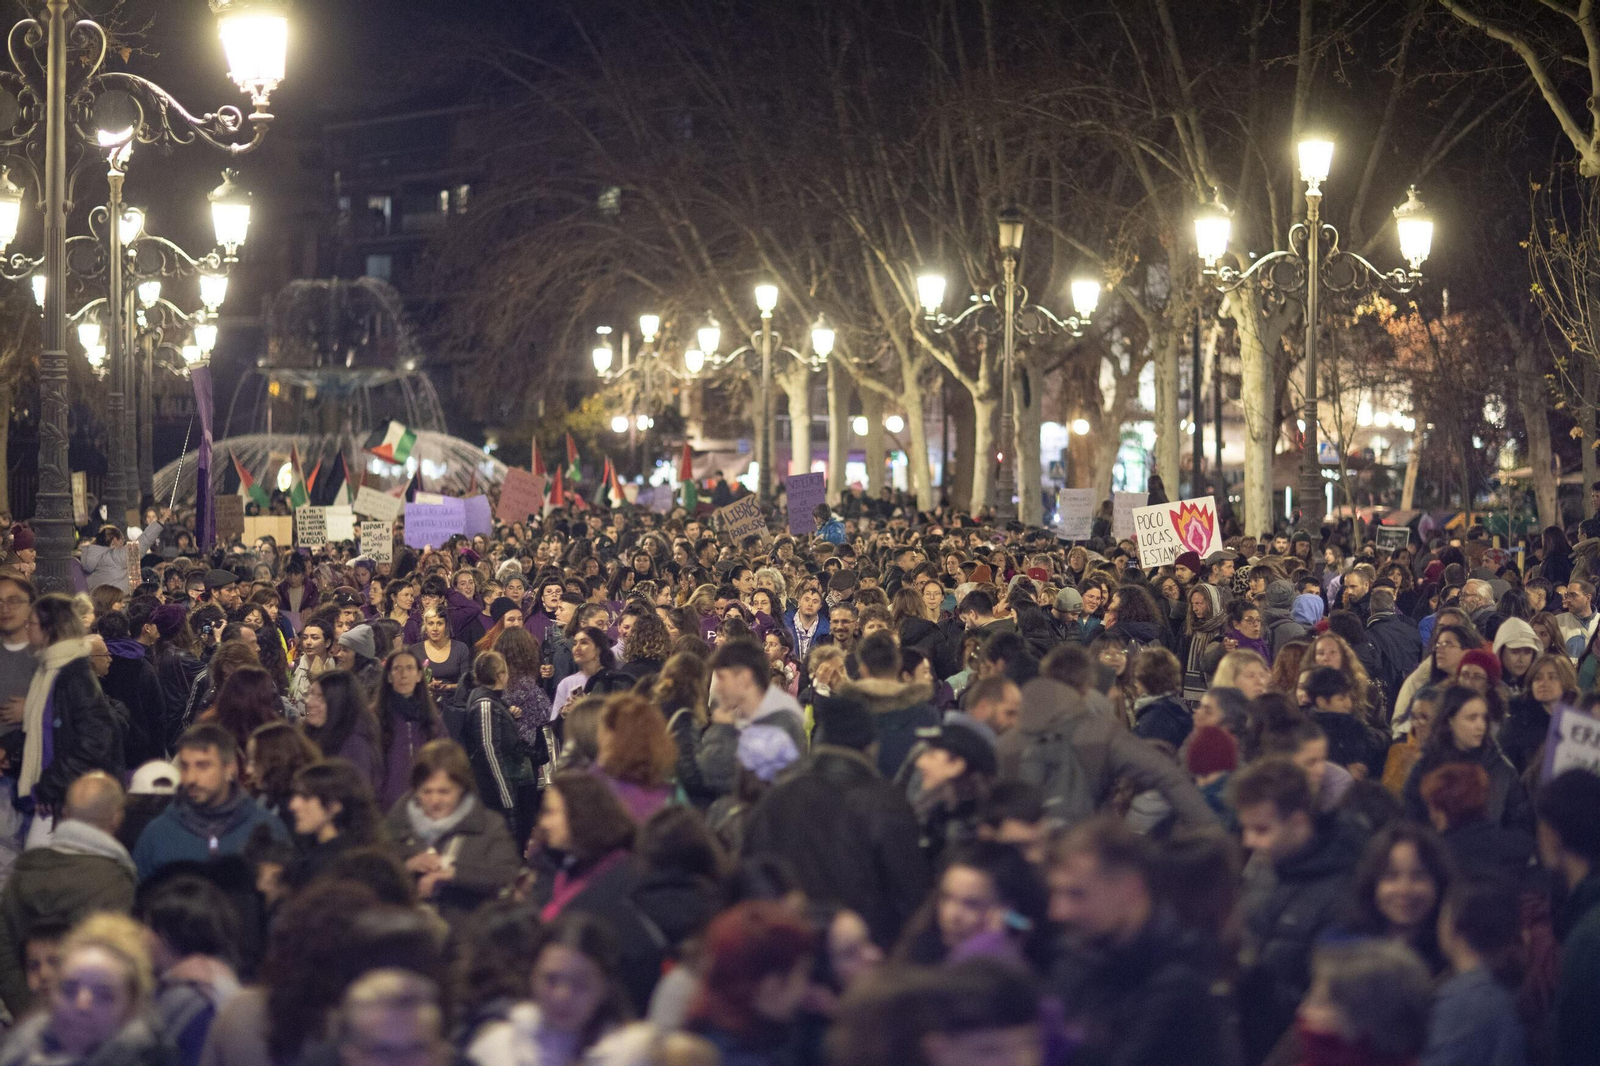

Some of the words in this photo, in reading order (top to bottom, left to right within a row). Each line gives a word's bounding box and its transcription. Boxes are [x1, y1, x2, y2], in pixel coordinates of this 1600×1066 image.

[724, 497, 762, 526] LIBRES
[1137, 511, 1164, 531] POCO
[730, 518, 766, 540] PODEROSAS
[1141, 528, 1173, 547] LOCAS
[1142, 543, 1186, 566] ESTAMOS
